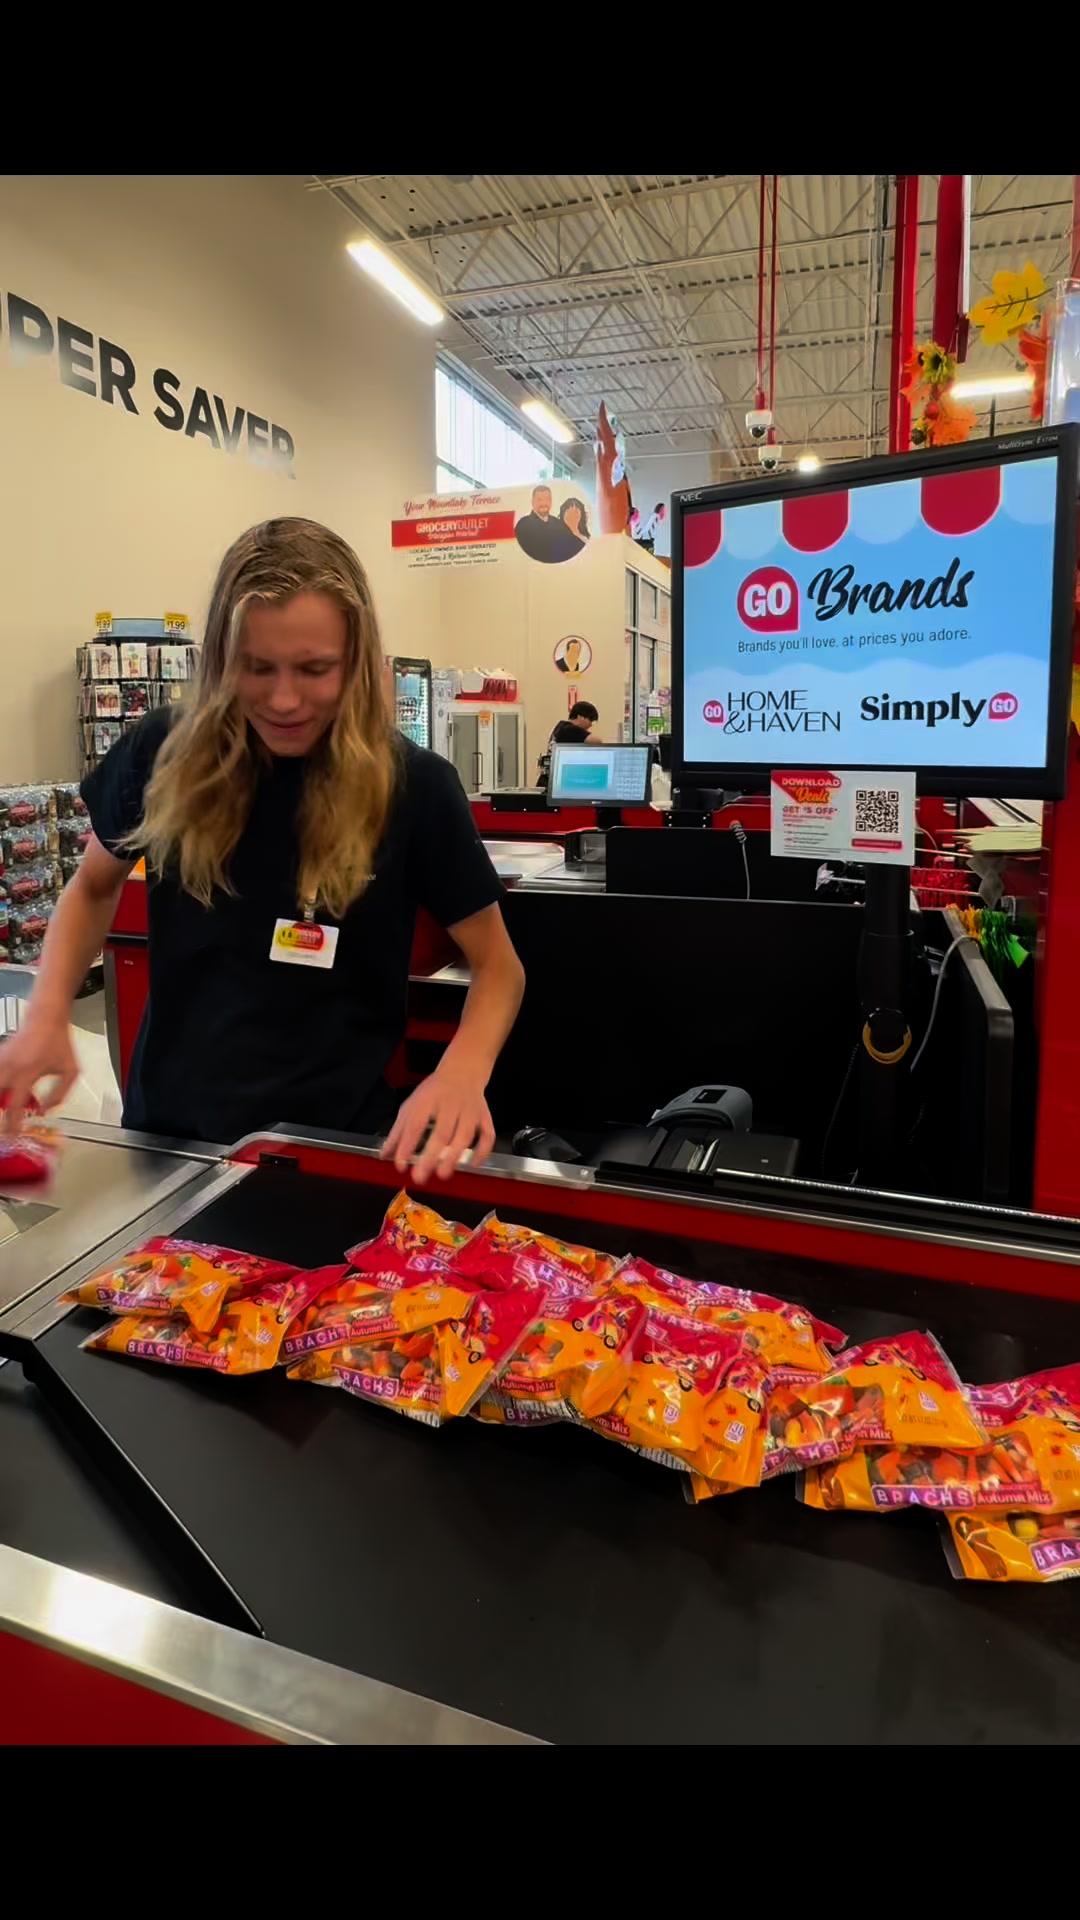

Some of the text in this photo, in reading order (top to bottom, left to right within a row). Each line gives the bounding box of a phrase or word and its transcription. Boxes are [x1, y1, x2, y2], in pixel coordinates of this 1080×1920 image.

[153, 367, 297, 481] SAVER
[680, 491, 703, 502] NEC
[743, 557, 975, 622] GO Brands
[738, 640, 776, 653] Brands
[779, 638, 808, 654] you'll
[842, 634, 854, 647] at
[859, 632, 897, 649] prices
[901, 632, 924, 648] you
[929, 627, 972, 643] adore.
[728, 690, 808, 710] HOME
[704, 708, 722, 718] GO
[860, 691, 1016, 727] Simply GO
[723, 711, 840, 735] &HAVEN
[782, 778, 840, 786] DOWNLOAD
[501, 1379, 555, 1392] Autumn Mix
[611, 1421, 629, 1435] Mix
[869, 1427, 891, 1440] Mix
[977, 1490, 1024, 1505] Autumn
[1027, 1488, 1053, 1503] Mix
